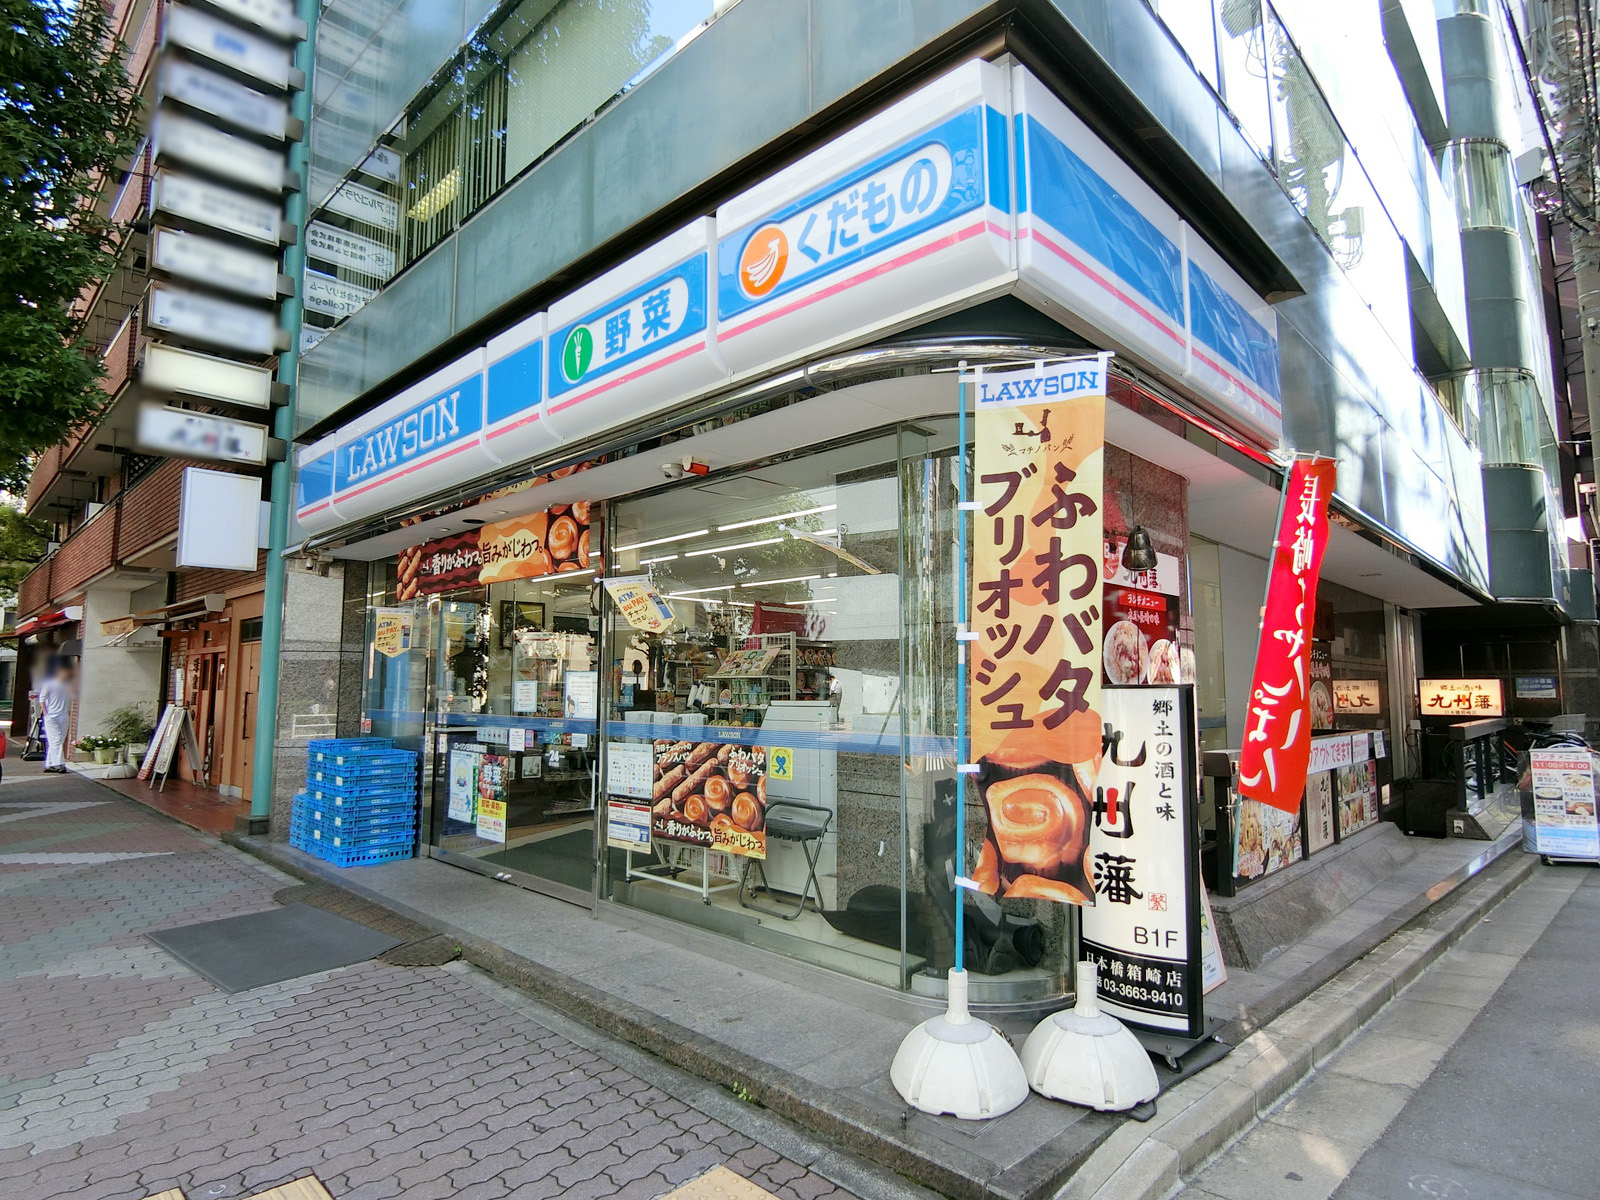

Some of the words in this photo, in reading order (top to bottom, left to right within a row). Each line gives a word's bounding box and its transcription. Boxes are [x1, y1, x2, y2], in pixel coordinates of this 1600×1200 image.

[796, 157, 939, 264] くだもの
[604, 288, 672, 360] 野菜
[981, 371, 1099, 403] LAWSON
[346, 390, 461, 483] LAWSON
[1018, 443, 1060, 456] マチノパン
[976, 461, 1038, 730] ブリオッシュ
[1023, 461, 1100, 730] ふわバタ
[1127, 593, 1159, 607] ランチメニュー
[1427, 692, 1493, 710] 九州藩
[656, 752, 692, 764] フランスパン
[729, 746, 765, 763] ふわバタ
[1152, 699, 1177, 821] 郷土の酒と味
[1092, 722, 1147, 905] 九州藩
[1133, 926, 1179, 948] B1F
[1086, 952, 1183, 988] 日本橋箱崎店
[1103, 978, 1183, 1006] 03-3663-9410
